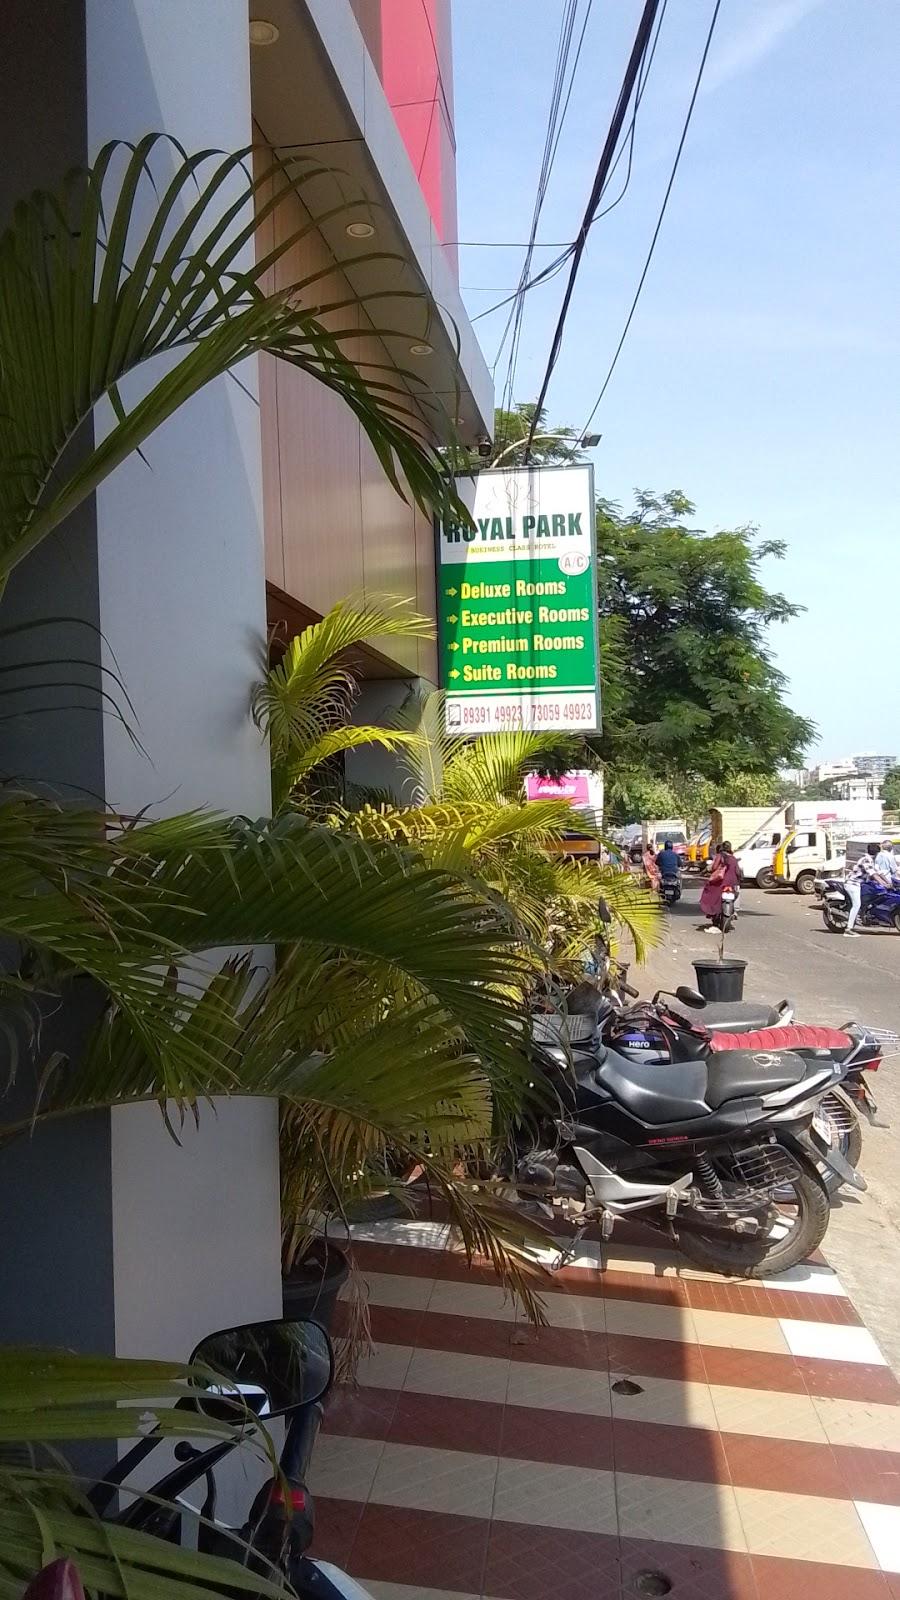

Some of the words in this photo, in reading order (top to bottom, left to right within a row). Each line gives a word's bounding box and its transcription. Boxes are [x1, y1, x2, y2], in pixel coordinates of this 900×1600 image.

[446, 517, 515, 543] ROYAL
[522, 513, 583, 539] PARK
[470, 546, 505, 554] BUSINESS
[564, 556, 584, 568] A/C
[460, 583, 511, 599] Deluxe
[515, 579, 567, 597] Rooms
[461, 608, 533, 627] Executive
[538, 606, 590, 623] Rooms
[462, 636, 529, 654] Premium
[533, 634, 585, 651] Rooms
[463, 665, 502, 682] Suite
[506, 663, 558, 680] Rooms
[463, 706, 491, 724] 89391
[494, 705, 523, 722] 49923
[531, 704, 560, 721] 73059
[563, 703, 592, 720] 49923
[628, 1040, 650, 1048] Hero
